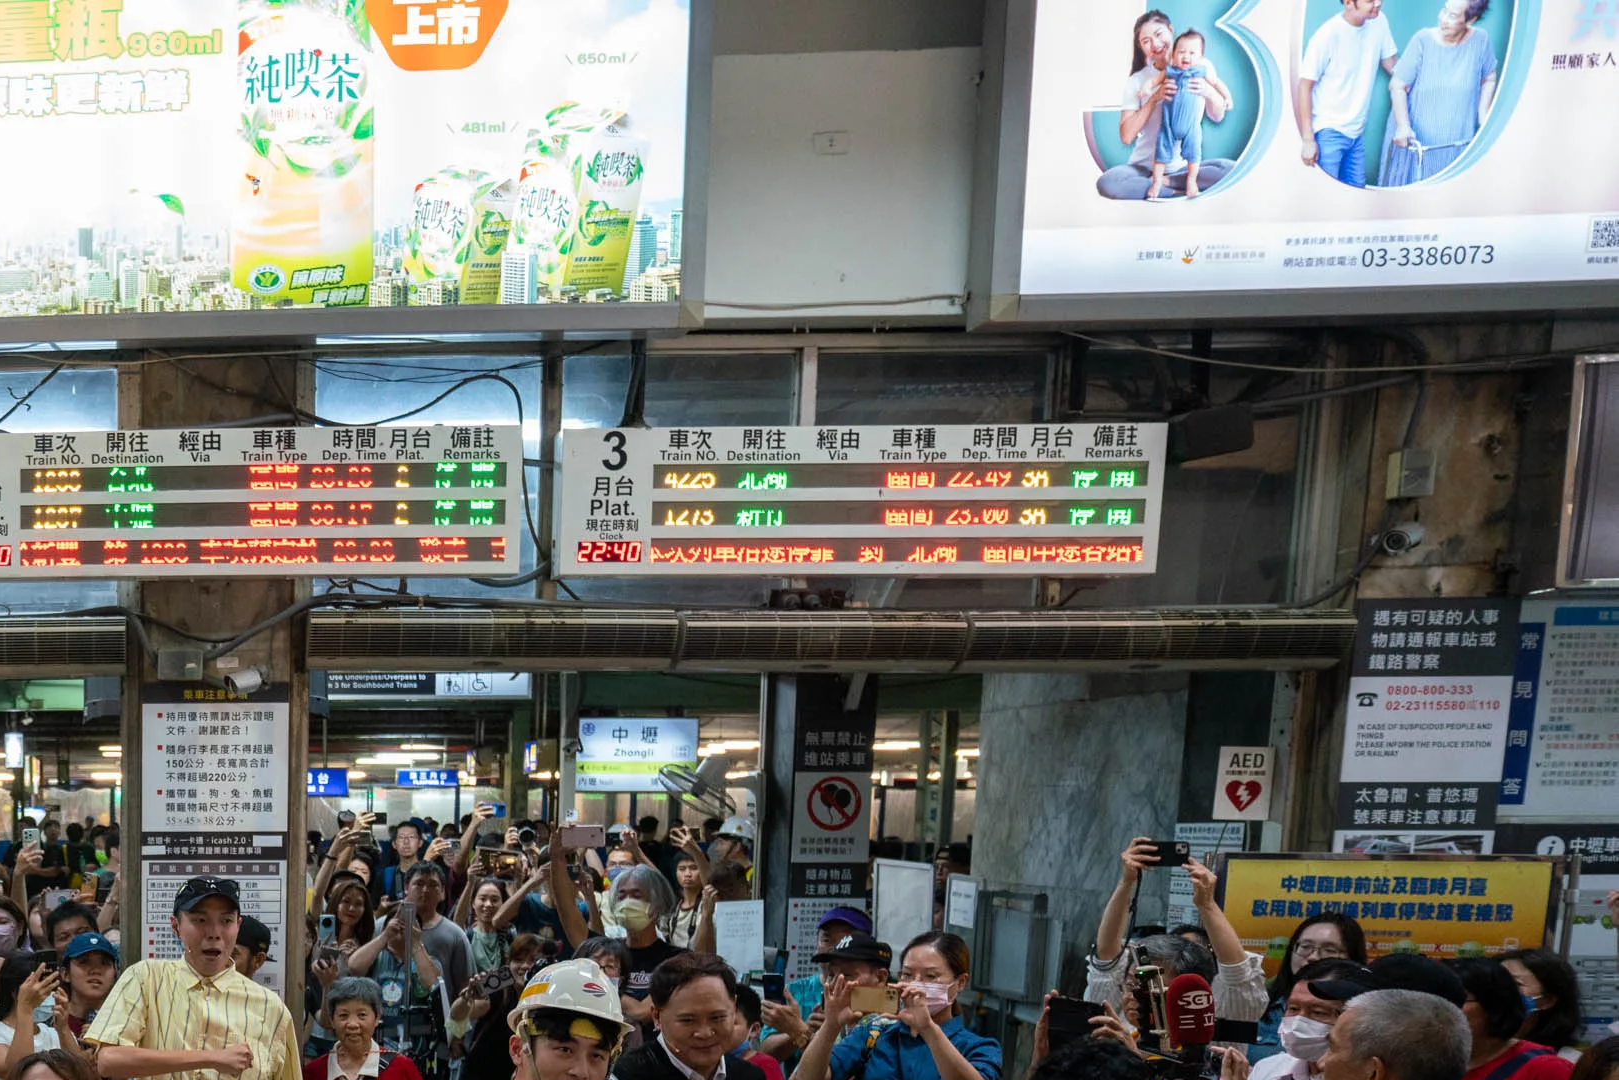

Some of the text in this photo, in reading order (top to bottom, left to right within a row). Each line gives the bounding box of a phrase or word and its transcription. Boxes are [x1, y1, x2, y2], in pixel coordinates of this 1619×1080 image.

[392, 4, 481, 46] 上市
[127, 29, 222, 57] 960ml
[577, 53, 626, 65] 650ml
[245, 49, 360, 104] 純喫茶
[461, 122, 505, 134] 481ml
[1362, 244, 1495, 268] 03-3386073
[34, 427, 494, 453] 車次 開往 經由 車種 時間 月台 備註
[669, 426, 1138, 450] 車次 開往 經由 車種 時間 月台 備註
[25, 449, 500, 466] Train NO. Destination Via Train Type Dep. Time Plat. Remarks
[602, 431, 628, 471] 3
[660, 447, 1143, 462] Train NO. Destination Via Train Type Dep. Time Plat. Remarks
[593, 477, 634, 496] 月台
[590, 500, 635, 516] Plat.
[585, 519, 638, 531] 現在時刻
[577, 542, 642, 562] 22:40
[1374, 609, 1499, 626] 遇有可疑的人事
[1372, 632, 1497, 648] 物請通報車站或
[1369, 654, 1441, 670] 鐵路警察
[1387, 685, 1474, 695] 0800-800-333
[166, 712, 273, 722] 持用優待票請出示證明
[612, 726, 658, 744] 中壢
[166, 744, 273, 754] 隨身行李長度不得超過
[613, 748, 654, 758] Zhongli
[1230, 753, 1264, 768] AED
[1353, 809, 1477, 825] 號乘車注意事項
